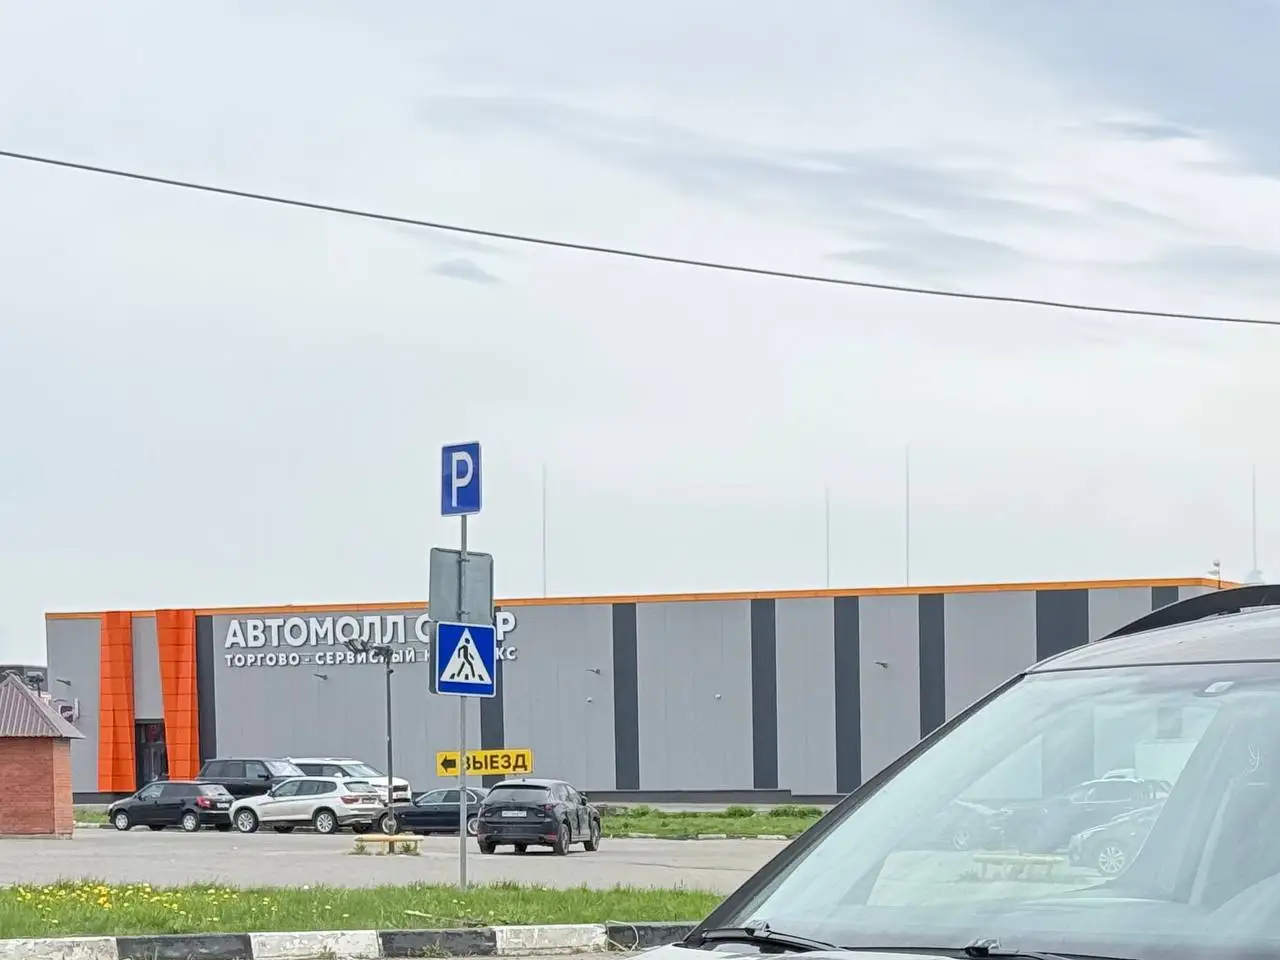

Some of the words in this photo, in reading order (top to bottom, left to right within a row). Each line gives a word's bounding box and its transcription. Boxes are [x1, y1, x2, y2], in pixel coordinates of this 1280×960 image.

[224, 614, 405, 649] АВТОМОЛЛ
[224, 653, 299, 668] ТОРГОВО
[315, 646, 416, 666] СЕРВИСЫЙ
